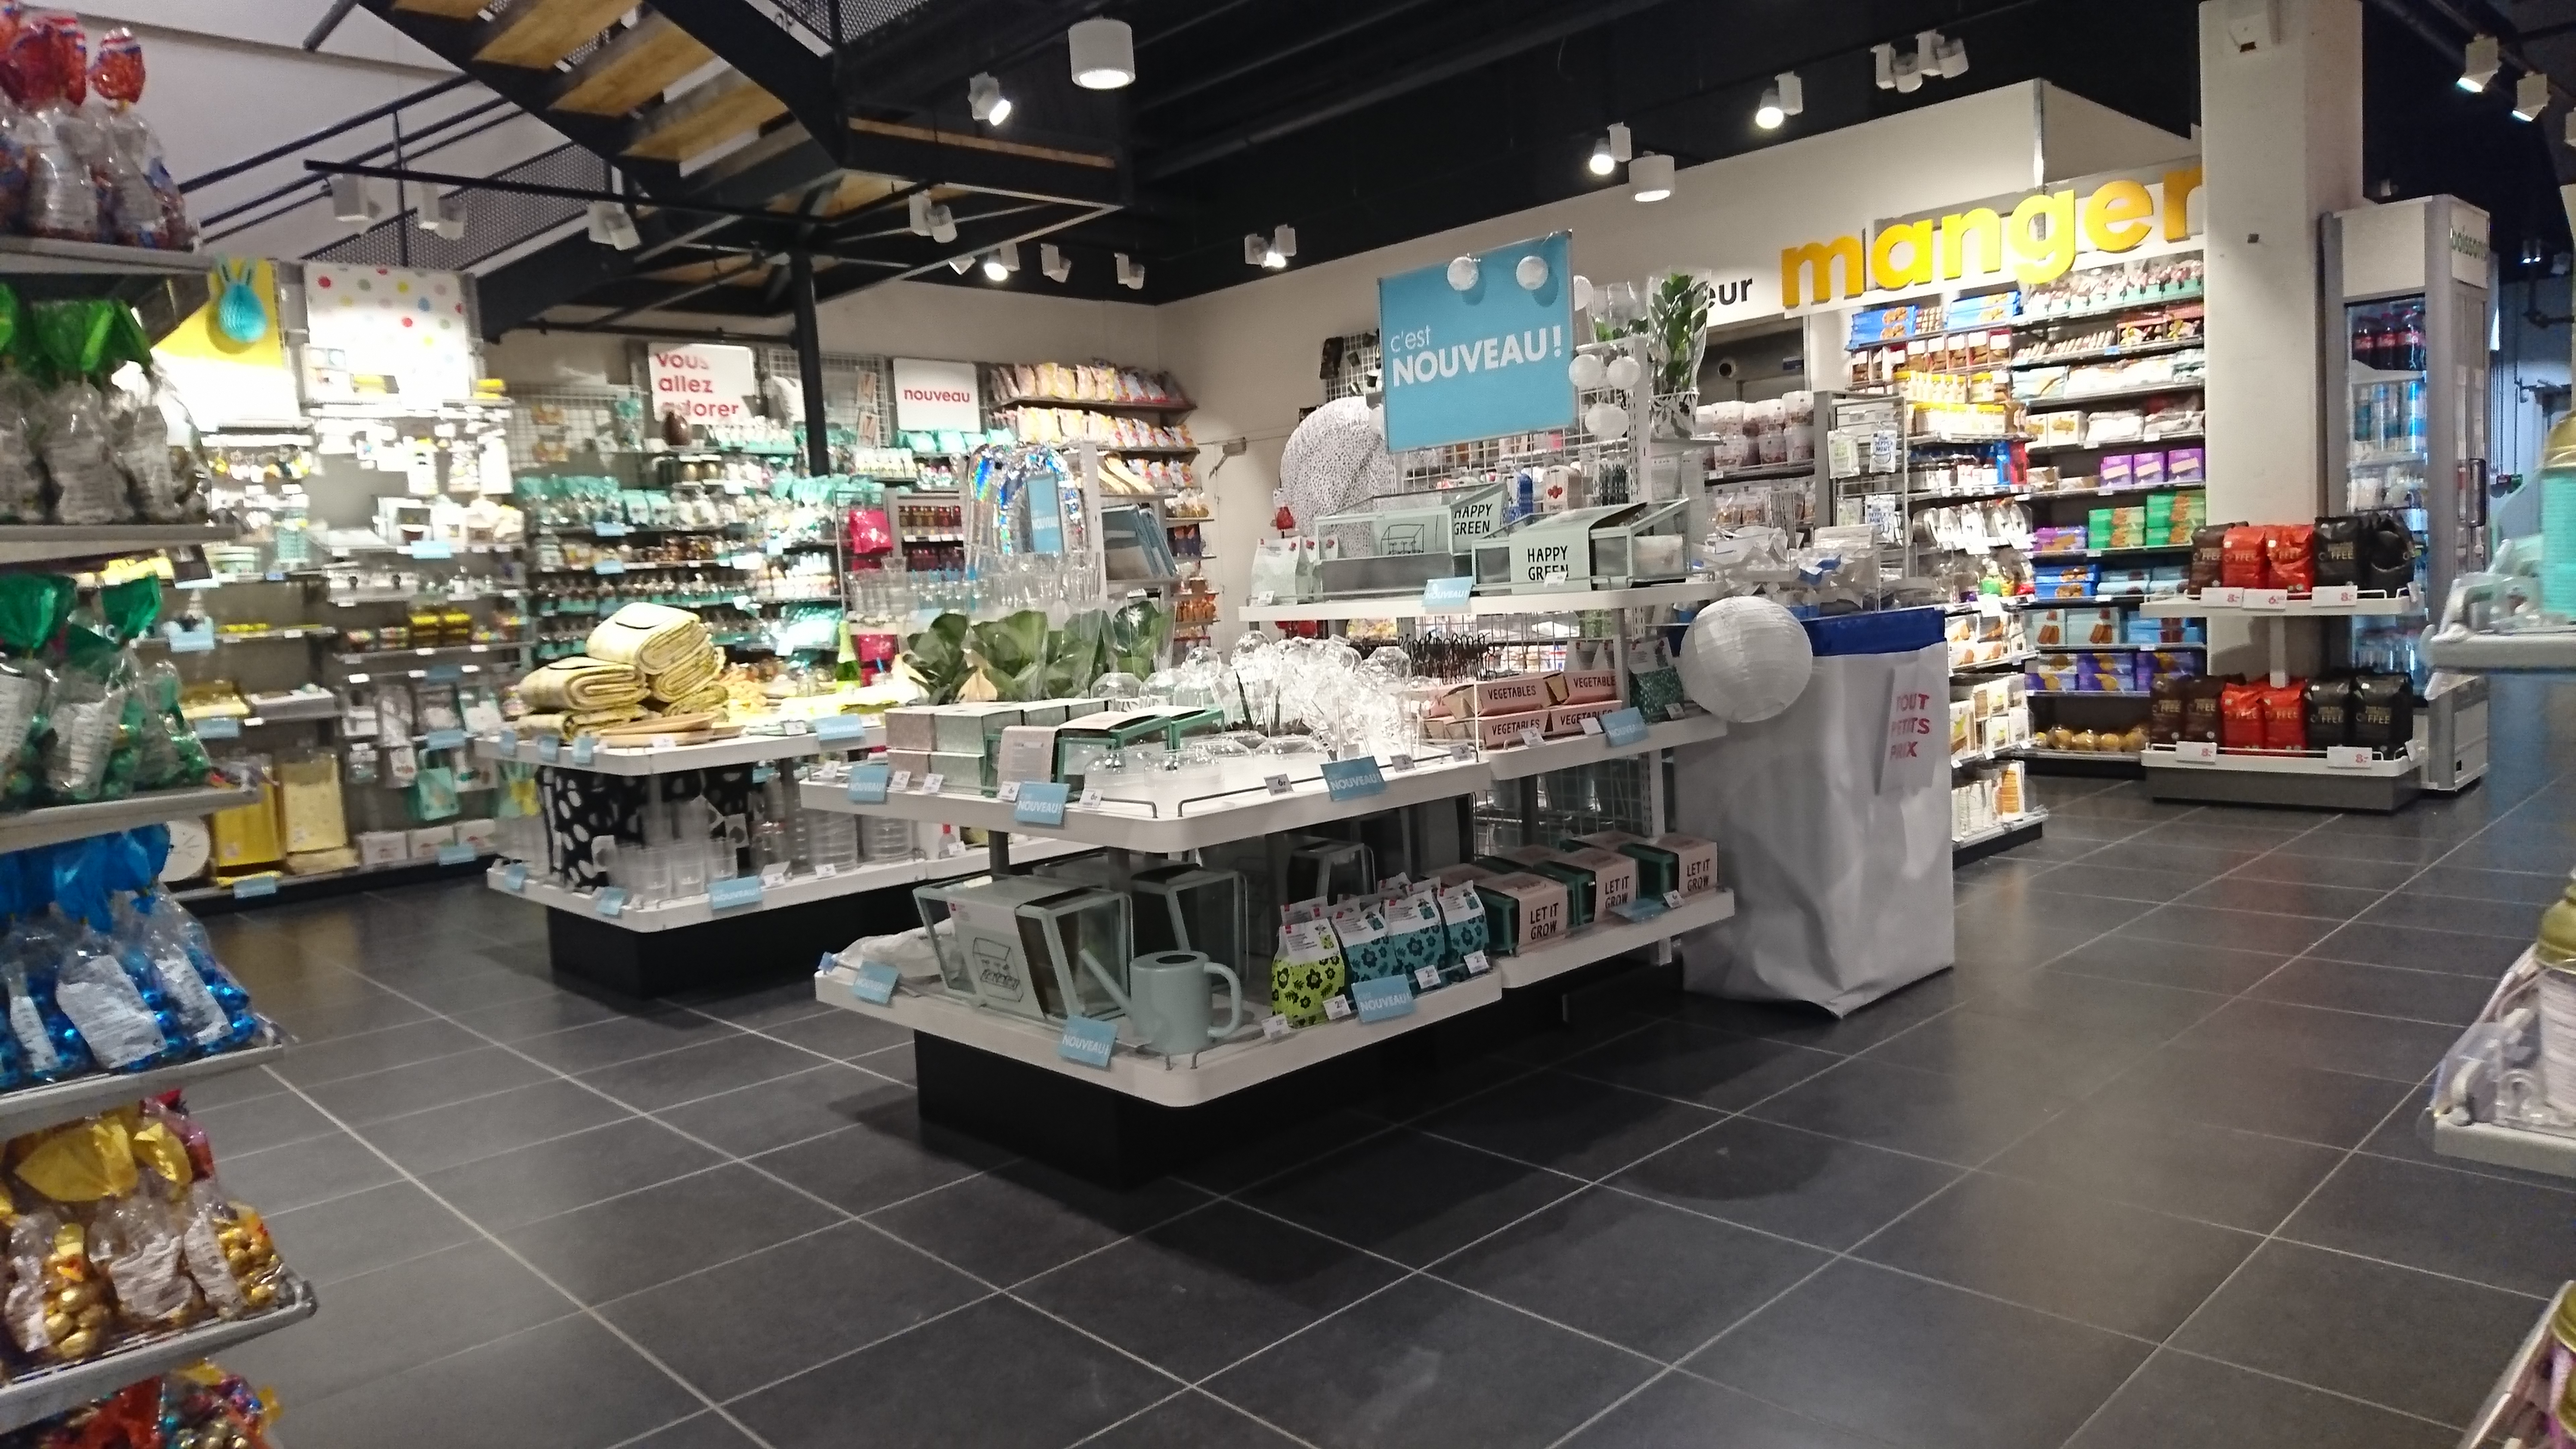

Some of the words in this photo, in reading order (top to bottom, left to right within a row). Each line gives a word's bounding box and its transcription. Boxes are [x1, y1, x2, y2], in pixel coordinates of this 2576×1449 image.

[1781, 166, 2203, 308] manger
[1390, 325, 1430, 353] c'est
[655, 353, 709, 369] vous
[659, 375, 713, 393] allez
[904, 389, 970, 402] nouveau
[1455, 503, 1492, 518] HAPPY
[1455, 520, 1490, 535] GREEN
[1527, 545, 1568, 563] HAPPY
[1528, 564, 1569, 580] GREEN
[1573, 676, 1616, 688] VEGETABLE
[1488, 685, 1536, 700] VEGETABLES
[1492, 719, 1540, 735] VEGETABLES
[1687, 863, 1700, 877] LET
[1703, 858, 1710, 870] IT
[1605, 878, 1620, 895] LET
[1622, 876, 1629, 889] IT
[1687, 875, 1709, 892] GROW
[1605, 892, 1628, 909] GROW
[1530, 907, 1547, 925] LET
[1550, 902, 1558, 917] IT
[1531, 920, 1557, 940] GROW
